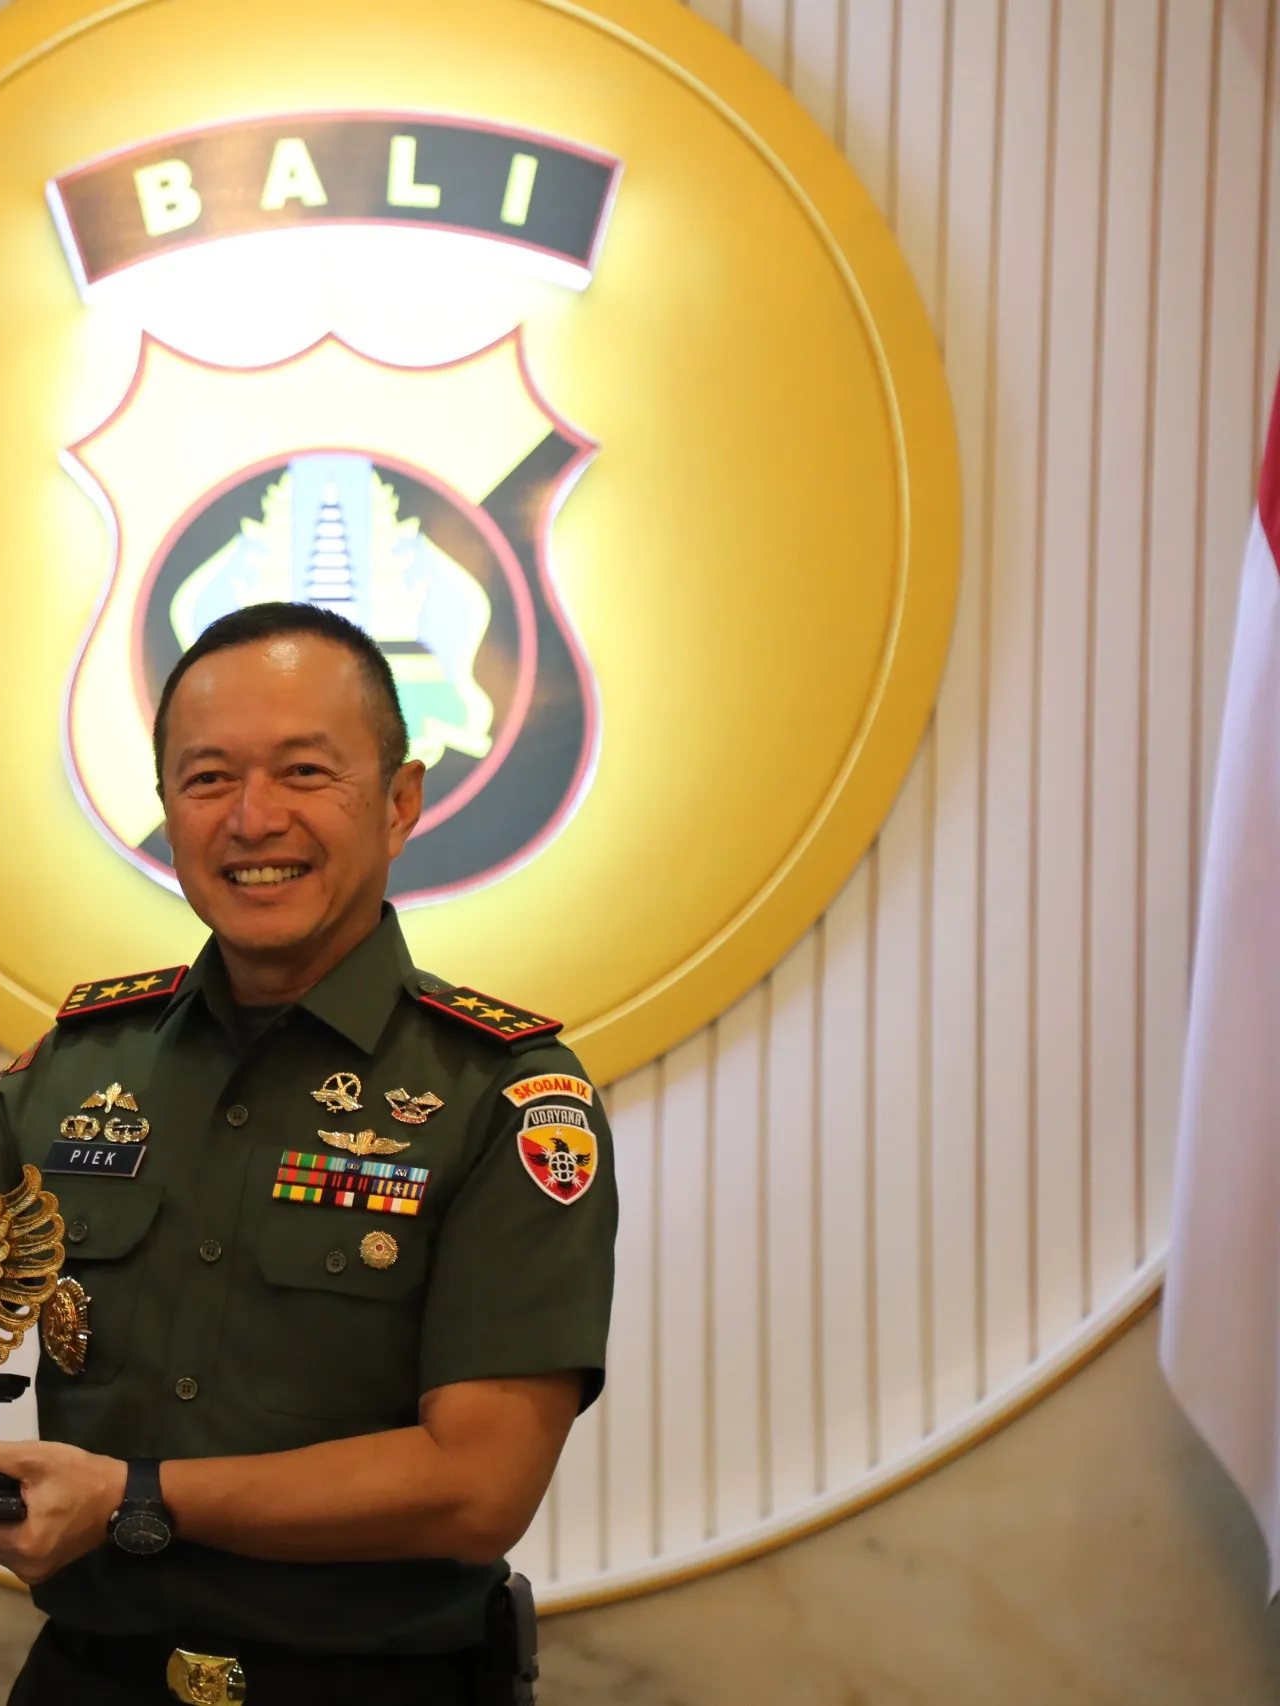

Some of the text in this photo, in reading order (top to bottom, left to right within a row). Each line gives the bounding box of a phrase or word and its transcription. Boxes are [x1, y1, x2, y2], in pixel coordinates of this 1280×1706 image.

[133, 134, 539, 238] BALI
[513, 1078, 588, 1099] SKODAM IX
[530, 1109, 582, 1127] UDAYANA
[70, 1149, 116, 1166] PIEK
